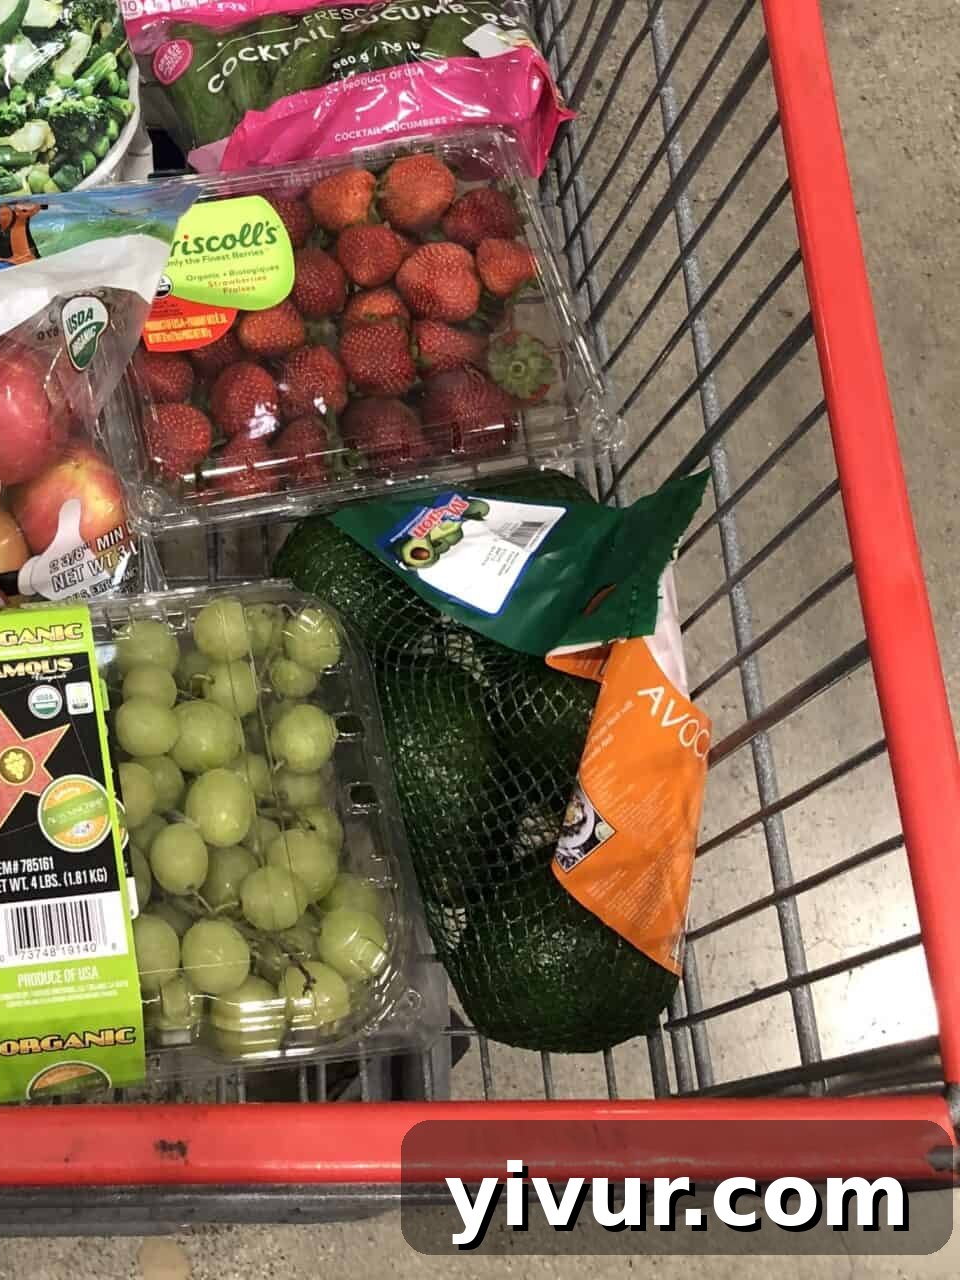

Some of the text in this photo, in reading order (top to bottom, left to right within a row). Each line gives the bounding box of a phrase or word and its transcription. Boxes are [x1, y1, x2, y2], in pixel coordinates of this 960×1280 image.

[207, 24, 335, 94] COCKTAIL
[342, 73, 386, 91] PRODUCT
[389, 71, 402, 81] OF
[171, 221, 278, 258] riscoll's
[185, 256, 201, 265] the
[202, 253, 230, 264] Finest
[232, 249, 264, 260] Berries
[186, 272, 220, 282] Organic
[208, 276, 268, 288] Strawberries
[65, 307, 94, 335] USDA
[96, 526, 124, 552] MIN
[51, 564, 85, 593] NET
[87, 552, 114, 577] WT
[21, 856, 55, 873] 785161
[10, 875, 29, 892] WT.
[30, 874, 38, 890] 4
[39, 873, 62, 889] LBS.
[63, 869, 88, 888] (1.81
[88, 866, 108, 883] KG)
[17, 966, 100, 988] PRODUCE OF USA
